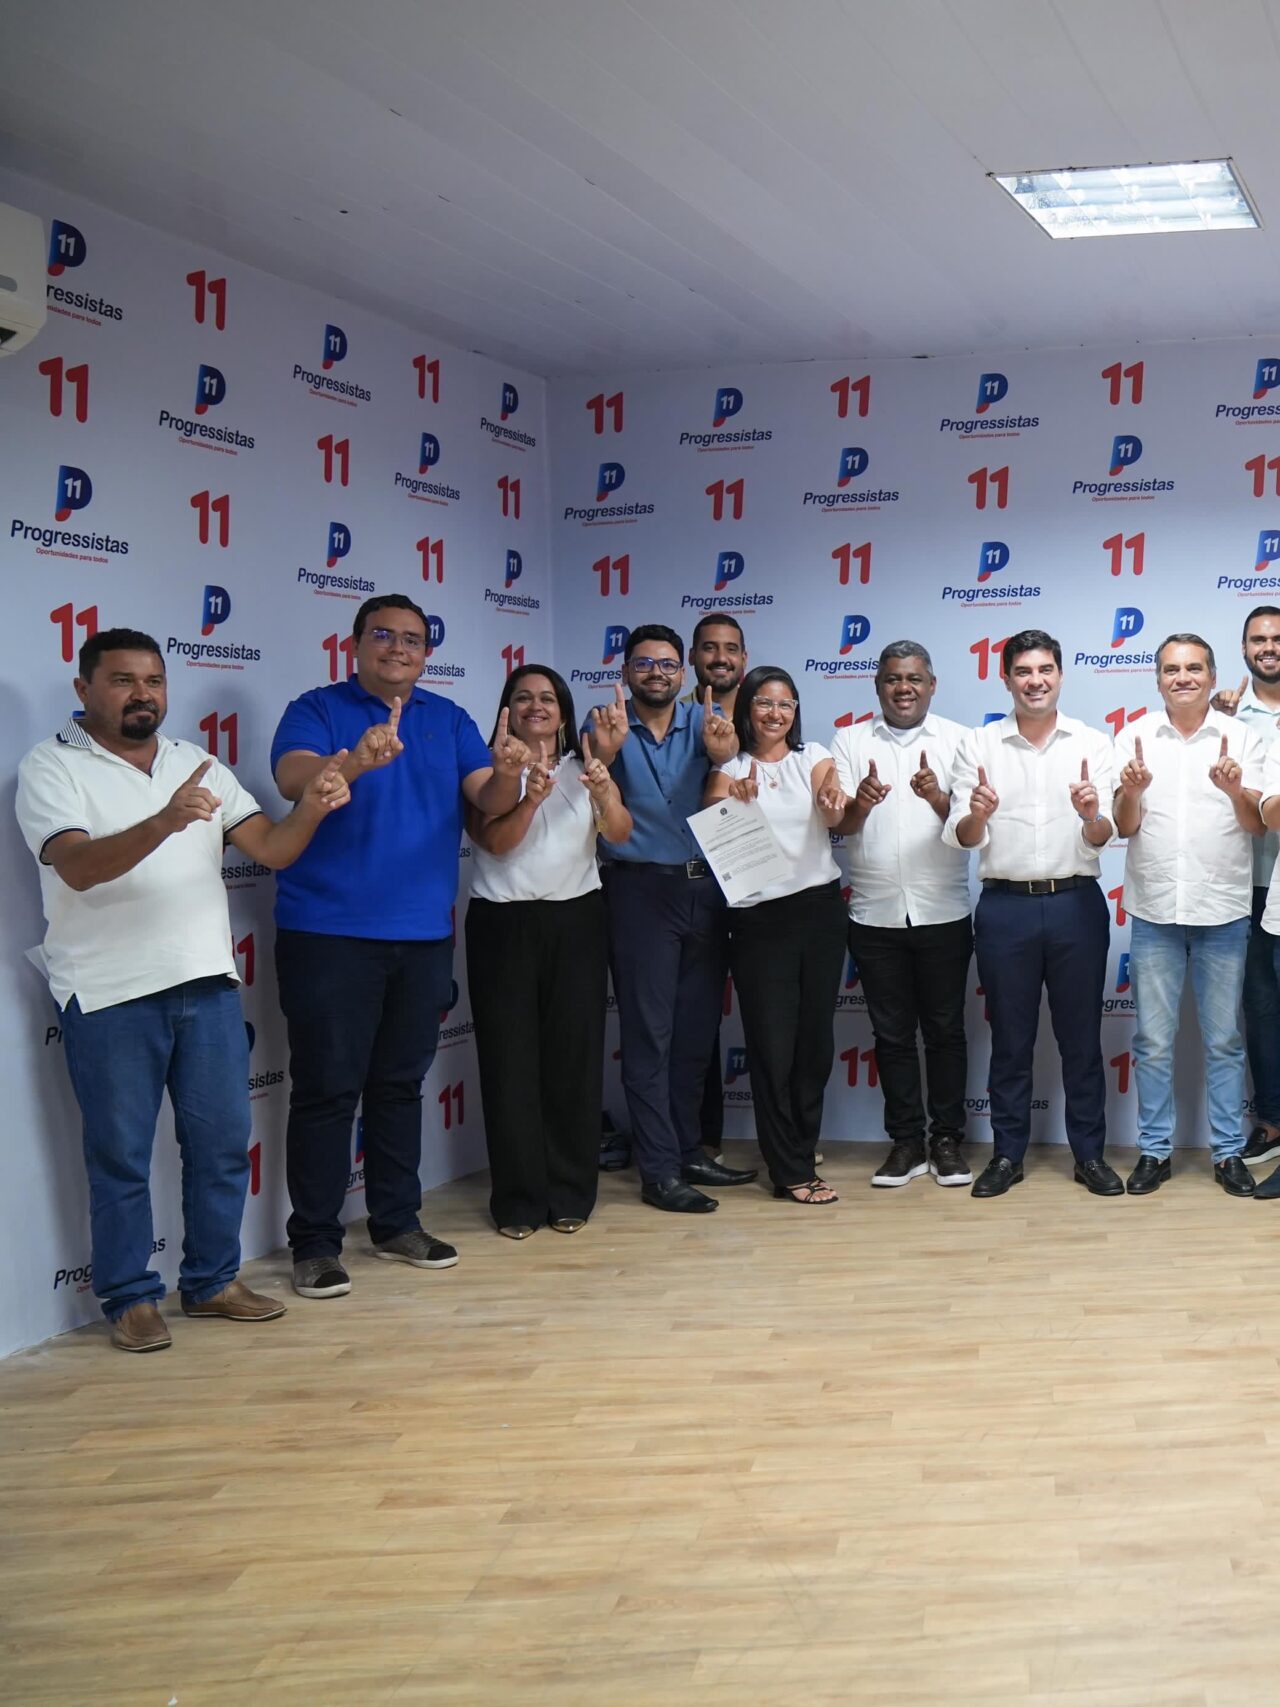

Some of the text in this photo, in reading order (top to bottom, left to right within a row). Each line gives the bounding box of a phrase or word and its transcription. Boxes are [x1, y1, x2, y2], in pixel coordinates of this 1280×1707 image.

[58, 234, 75, 256] 11
[46, 284, 123, 321] ressistas
[185, 269, 227, 332] 11
[329, 335, 340, 352] 11
[293, 364, 371, 402] Progressistas
[412, 354, 441, 403] 11
[1101, 361, 1145, 405] 11
[1262, 366, 1277, 381] 11
[38, 356, 90, 424] 11
[204, 376, 217, 395] 11
[985, 381, 999, 395] 11
[721, 395, 734, 409] 11
[830, 375, 871, 418] 11
[586, 392, 625, 435] 11
[158, 410, 255, 449] Progressistas
[481, 417, 536, 447] Progressistas
[939, 415, 1040, 434] Progressistas
[679, 429, 773, 447] Progressistas
[316, 434, 350, 487] 11
[1119, 443, 1133, 457] 11
[846, 455, 860, 469] 11
[394, 473, 461, 501] Progressistas
[604, 470, 616, 484] 11
[1072, 478, 1175, 496] Progressistas
[65, 478, 81, 499] 11
[497, 476, 521, 518] 11
[803, 489, 900, 507] Progressistas
[967, 466, 1010, 510] 11
[705, 479, 745, 520] 11
[190, 490, 230, 548] 11
[563, 502, 655, 522] Progressistas
[11, 520, 129, 555] Progressistas
[333, 532, 344, 548] 11
[1264, 538, 1279, 552] 11
[79, 554, 92, 562] para
[415, 537, 444, 584] 11
[831, 543, 872, 585] 11
[986, 550, 1000, 564] 11
[1103, 532, 1146, 577] 11
[592, 554, 630, 596] 11
[723, 559, 735, 573] 11
[297, 567, 375, 593] Progressistas
[485, 588, 540, 610] Progressistas
[680, 593, 774, 610] Progressistas
[941, 584, 1041, 602] Progressistas
[209, 596, 222, 614] 11
[848, 623, 861, 637] 11
[1120, 615, 1134, 630] 11
[166, 637, 261, 662] Progressistas
[610, 633, 622, 647] 11
[570, 669, 622, 684] Progres
[805, 658, 880, 674] Progressis
[200, 712, 238, 766] 11
[221, 860, 271, 880] essistas
[840, 1046, 879, 1087] 11
[438, 1079, 465, 1131] 11
